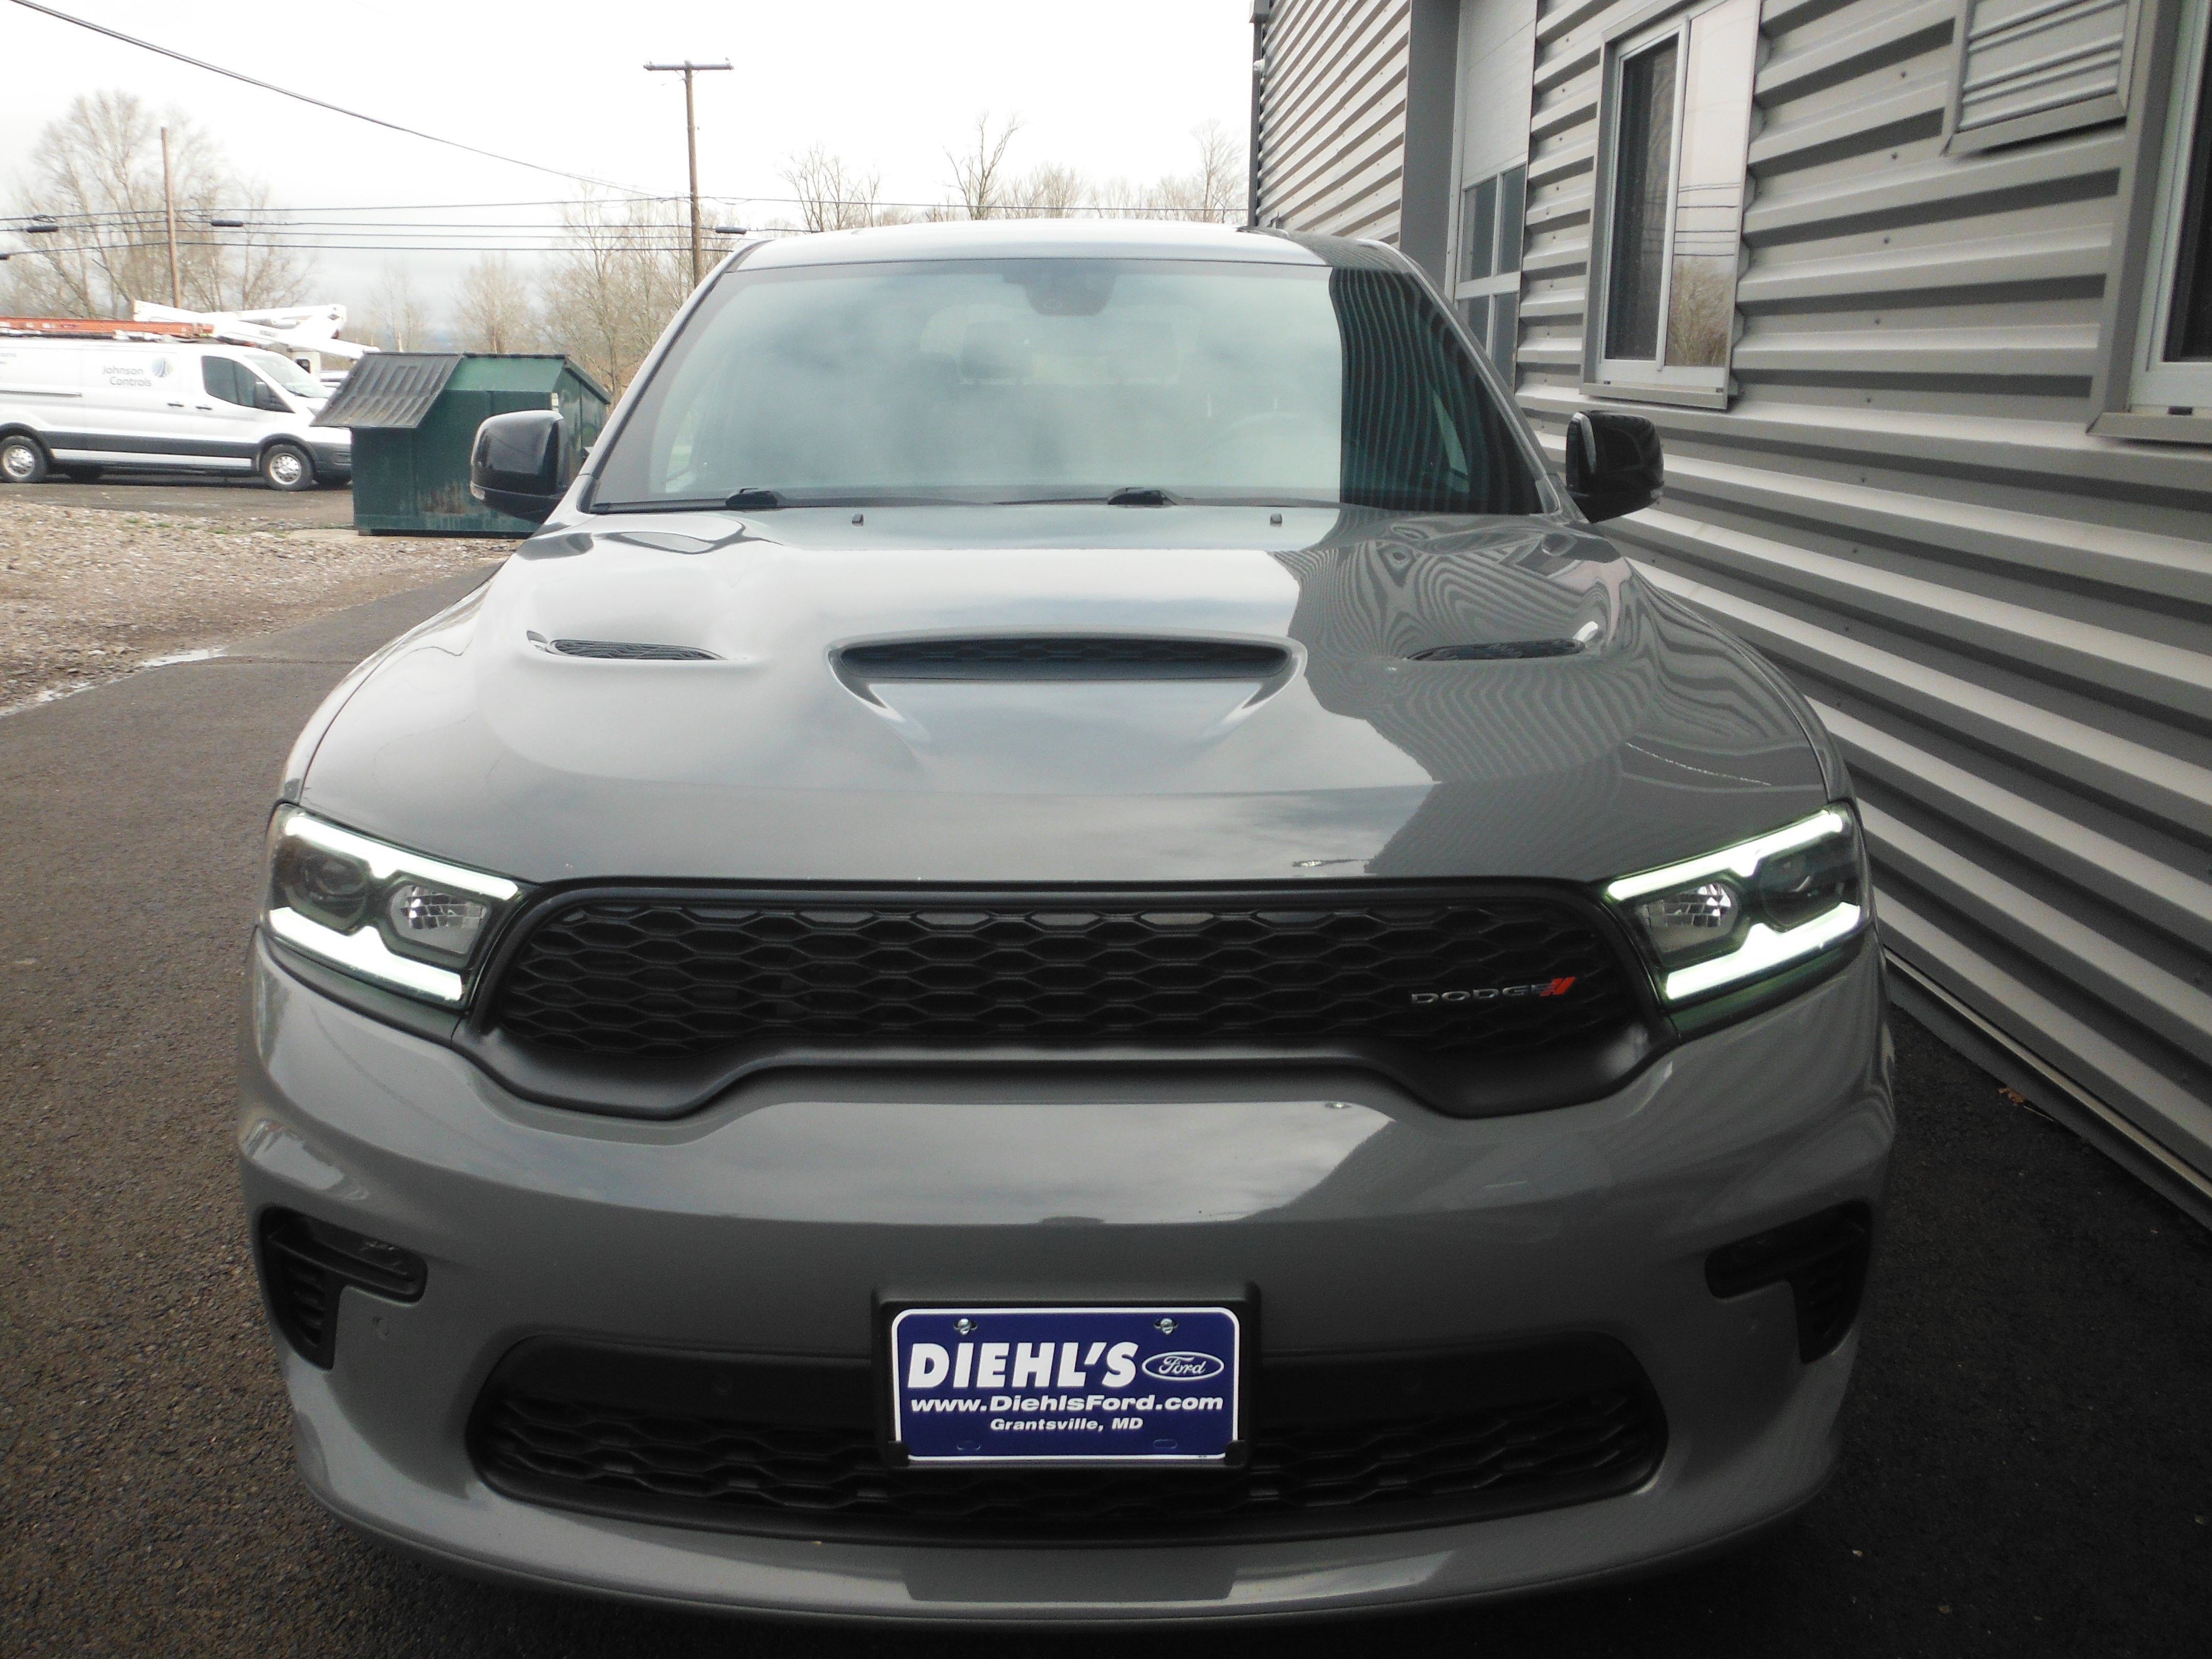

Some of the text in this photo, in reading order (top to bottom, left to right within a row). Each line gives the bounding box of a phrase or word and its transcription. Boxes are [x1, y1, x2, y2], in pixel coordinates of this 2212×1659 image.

[102, 365, 144, 375] Johnson
[110, 376, 152, 387] Controls
[1411, 984, 1551, 1004] DODGE
[907, 1342, 1206, 1389] DIEHL'S Ford
[911, 1394, 1224, 1412] www.DiehlsFord.com
[990, 1417, 1144, 1432] Grantsville, MD
